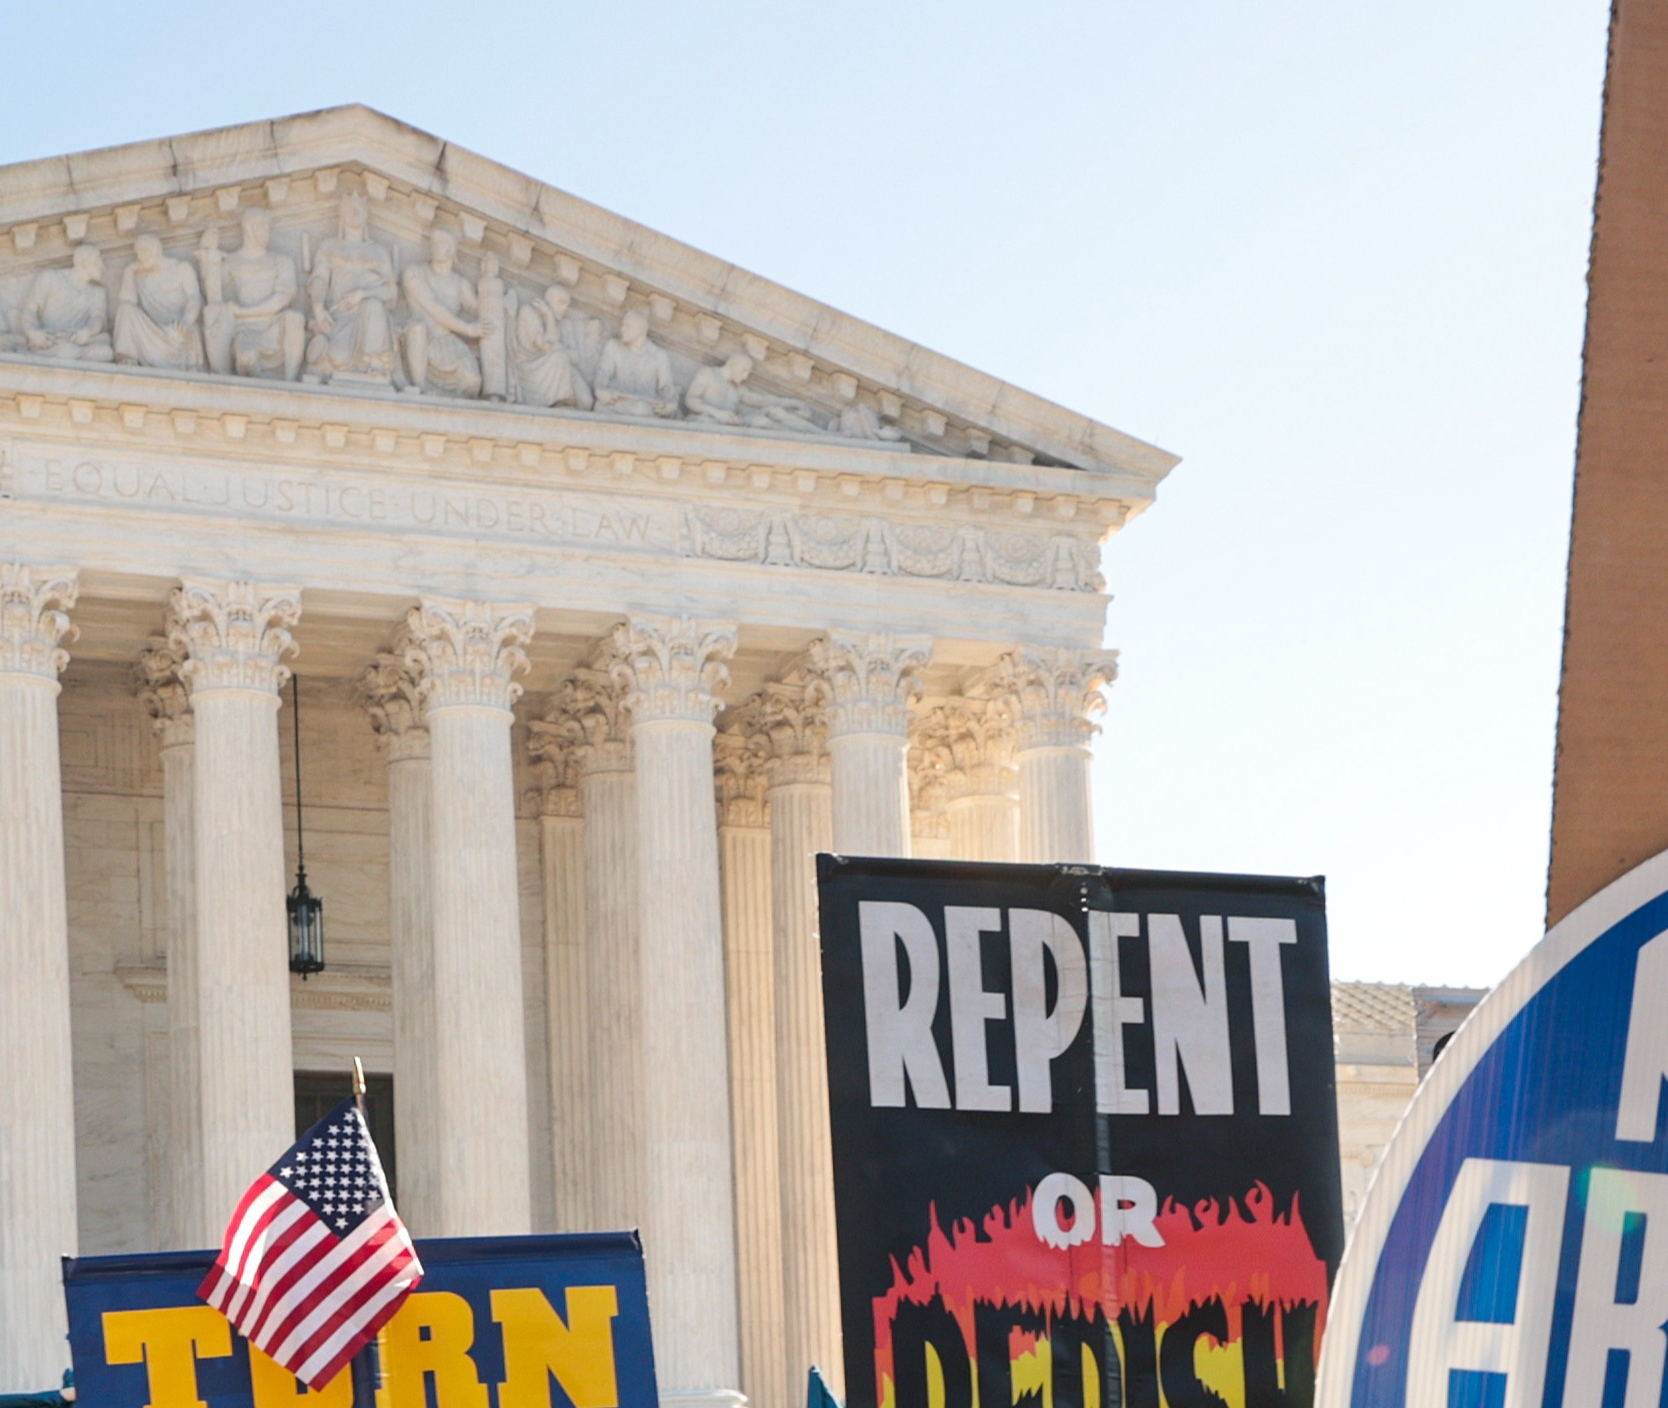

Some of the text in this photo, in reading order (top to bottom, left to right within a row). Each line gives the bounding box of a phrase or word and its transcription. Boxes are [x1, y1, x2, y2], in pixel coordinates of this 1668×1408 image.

[43, 459, 201, 505] EQUAL
[214, 478, 387, 521] JUSTICE
[410, 491, 564, 535] UNDER
[858, 901, 1297, 1116] REPENT
[1031, 1172, 1165, 1251] OR
